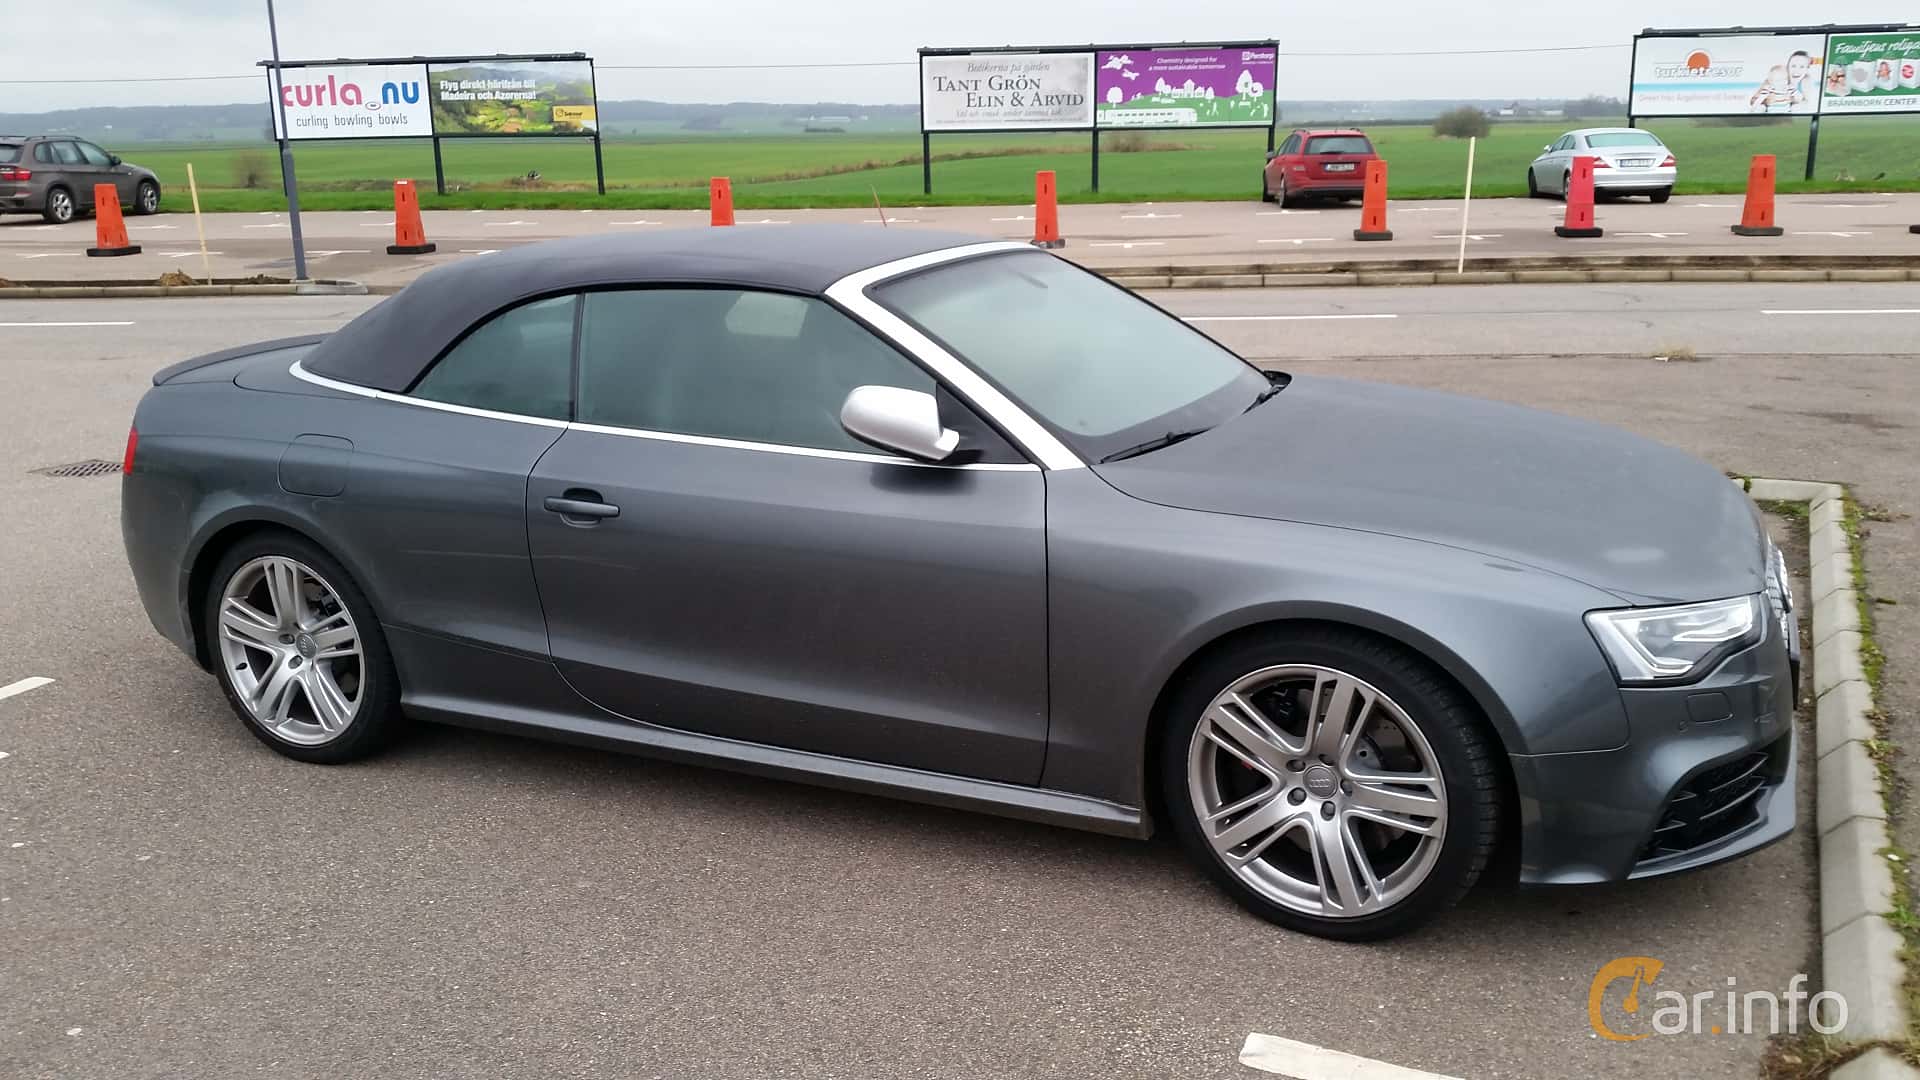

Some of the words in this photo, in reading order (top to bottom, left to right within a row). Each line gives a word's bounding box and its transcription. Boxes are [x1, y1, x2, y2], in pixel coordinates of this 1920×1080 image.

[1157, 57, 1184, 65] Chemistry
[440, 80, 459, 91] Flyg
[460, 80, 487, 90] direkt
[523, 79, 536, 89] till
[441, 91, 476, 101] Madeira
[477, 91, 494, 100] och
[1010, 91, 1024, 107] &
[296, 114, 329, 128] curling
[334, 113, 373, 128] bowling
[378, 113, 408, 125] bowls
